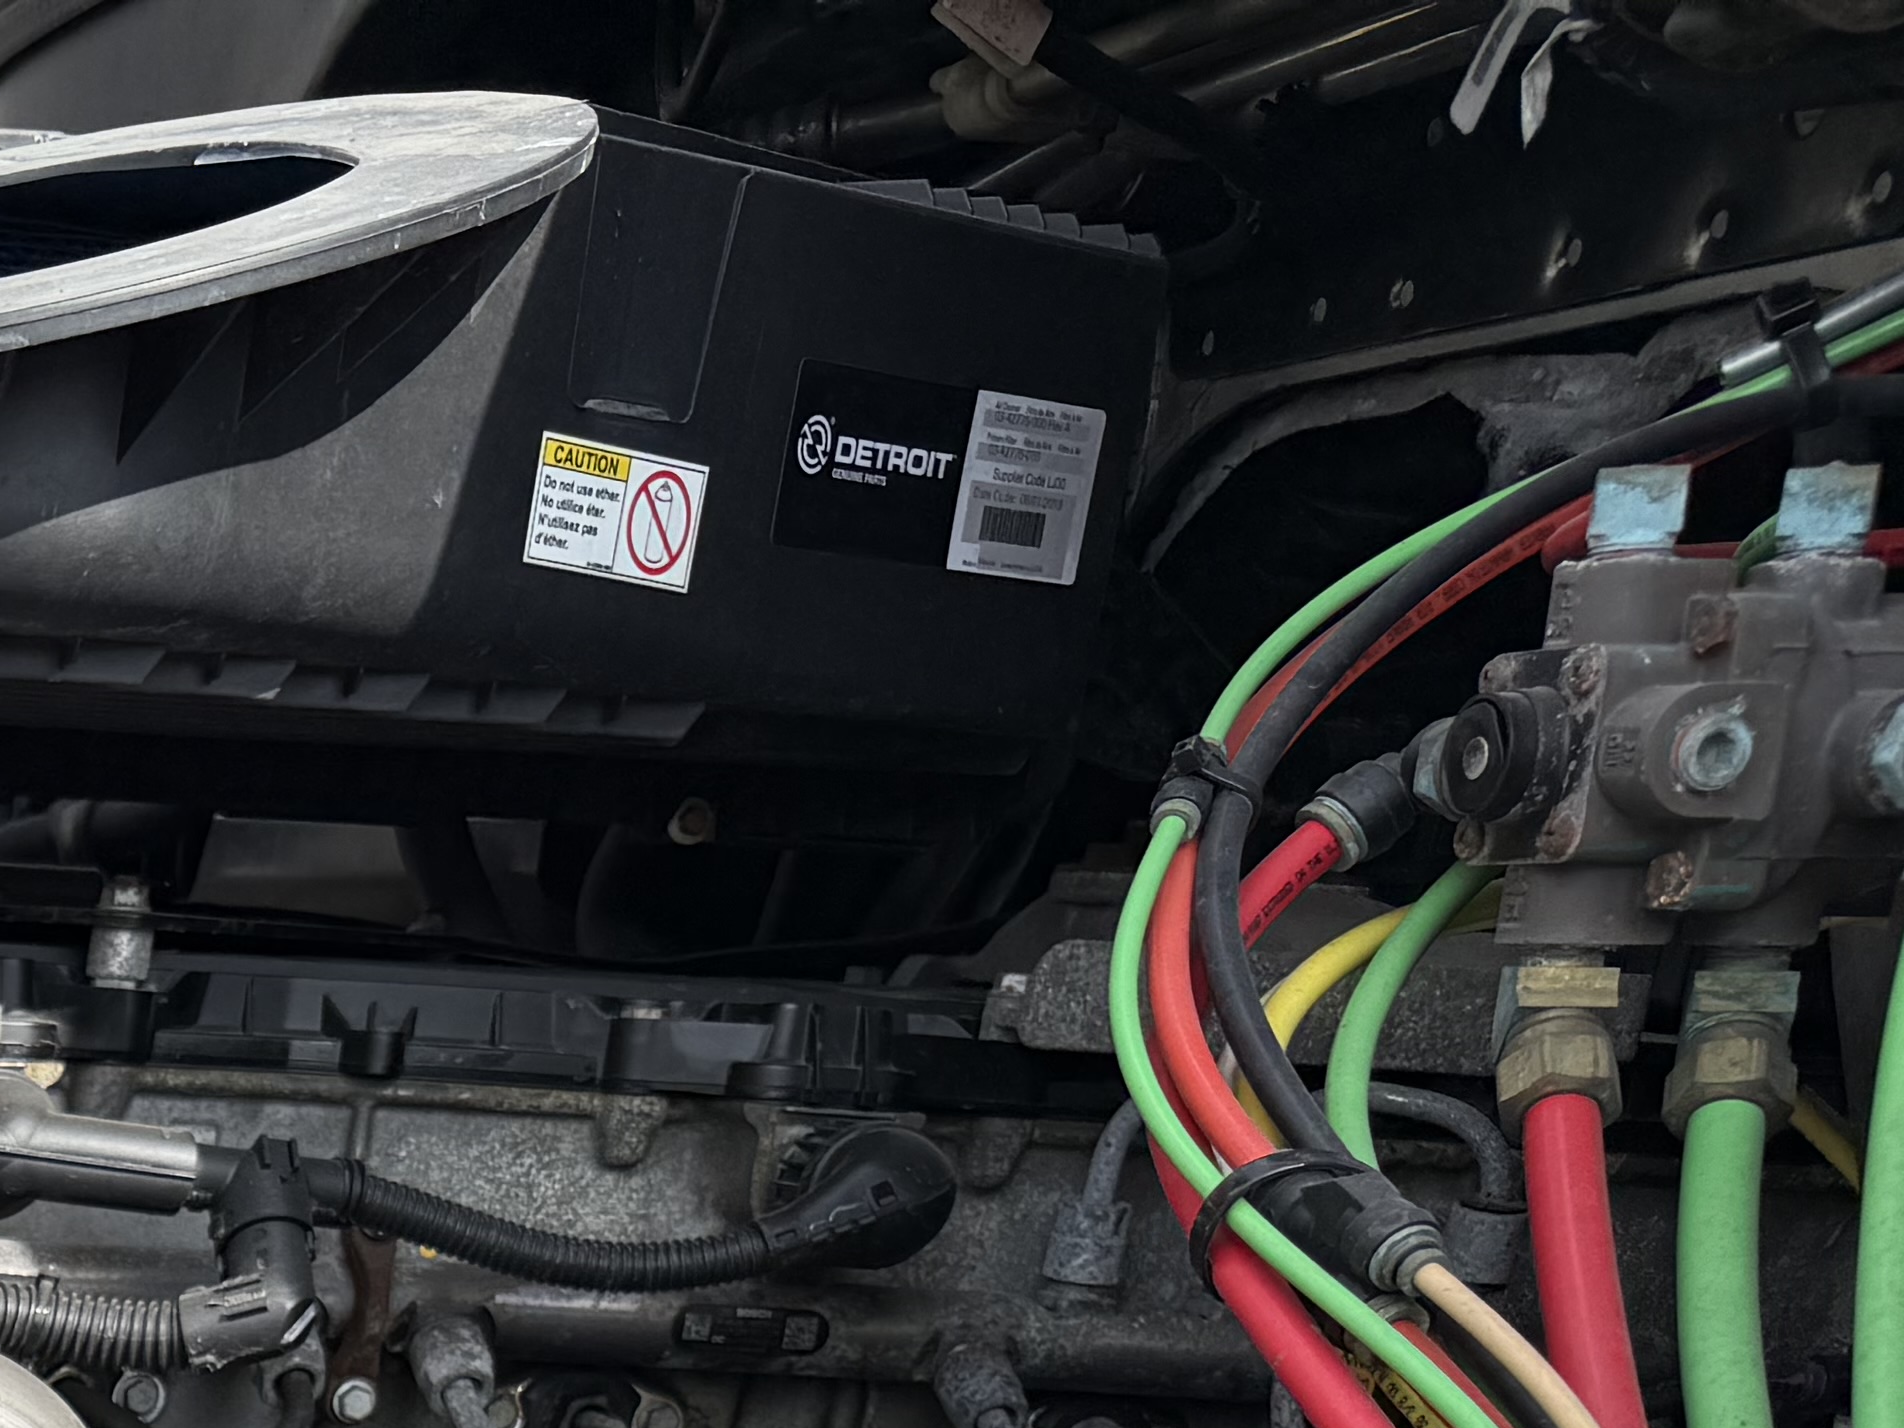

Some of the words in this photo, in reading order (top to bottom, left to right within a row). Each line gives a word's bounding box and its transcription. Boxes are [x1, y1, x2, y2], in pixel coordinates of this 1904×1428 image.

[553, 445, 620, 476] CAUTION
[834, 436, 953, 479] DETROIT
[544, 474, 557, 489] Do
[559, 479, 575, 493] not
[576, 485, 593, 497] use
[541, 494, 554, 509] No
[581, 525, 598, 537] pas
